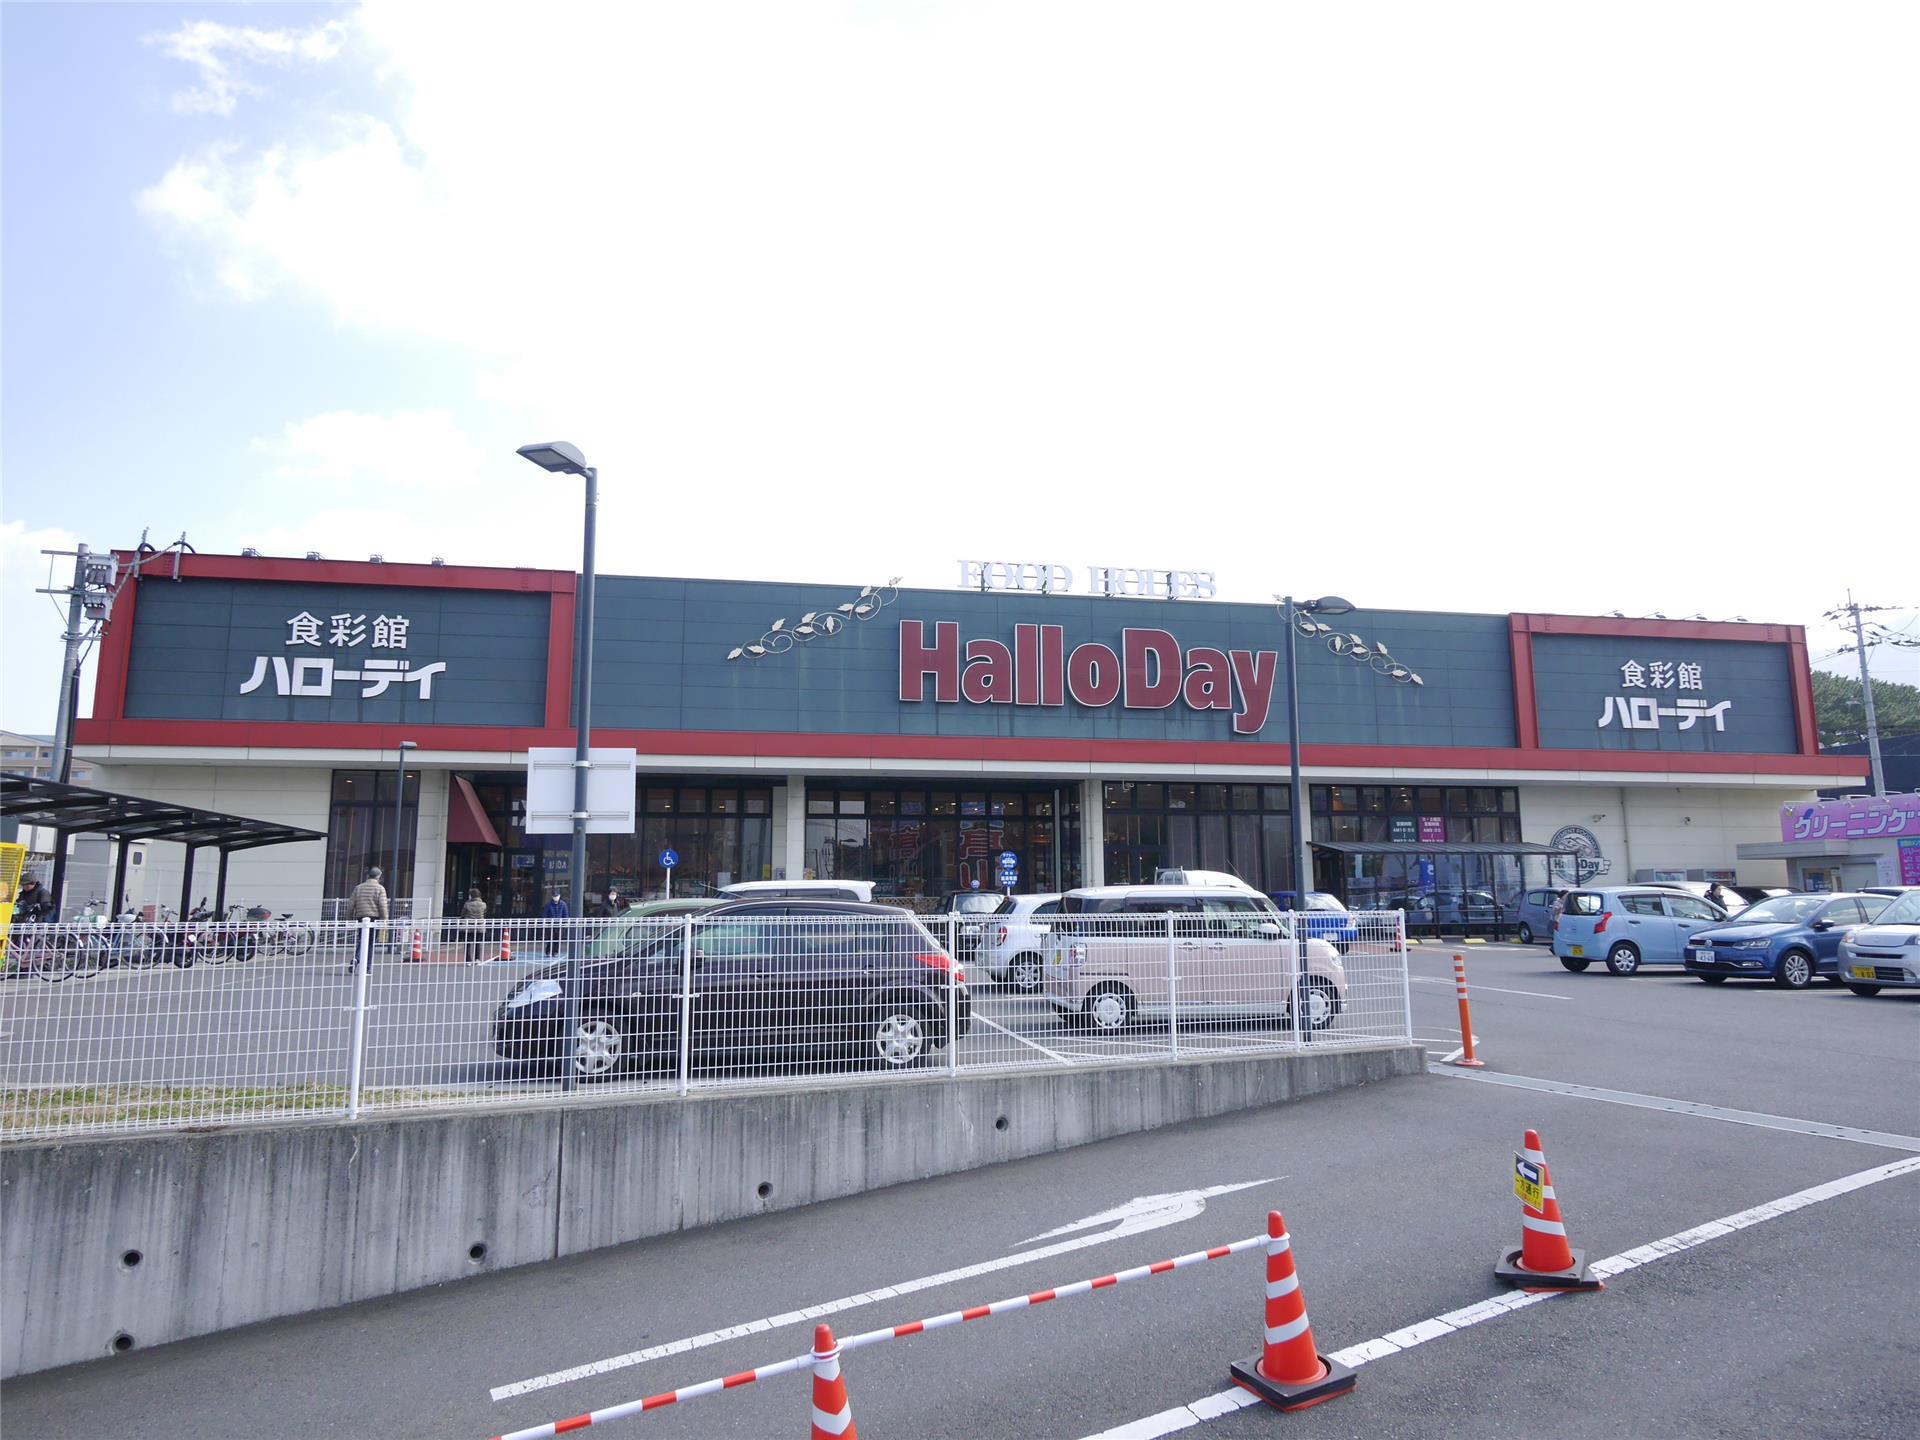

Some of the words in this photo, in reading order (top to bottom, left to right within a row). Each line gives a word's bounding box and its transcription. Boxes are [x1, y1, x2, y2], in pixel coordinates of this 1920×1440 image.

[957, 560, 1074, 593] FOOD
[285, 611, 410, 649] 食彩館
[899, 619, 1279, 735] HalloDay
[1620, 659, 1703, 690] 食彩館
[1793, 809, 1920, 839] クリーニング
